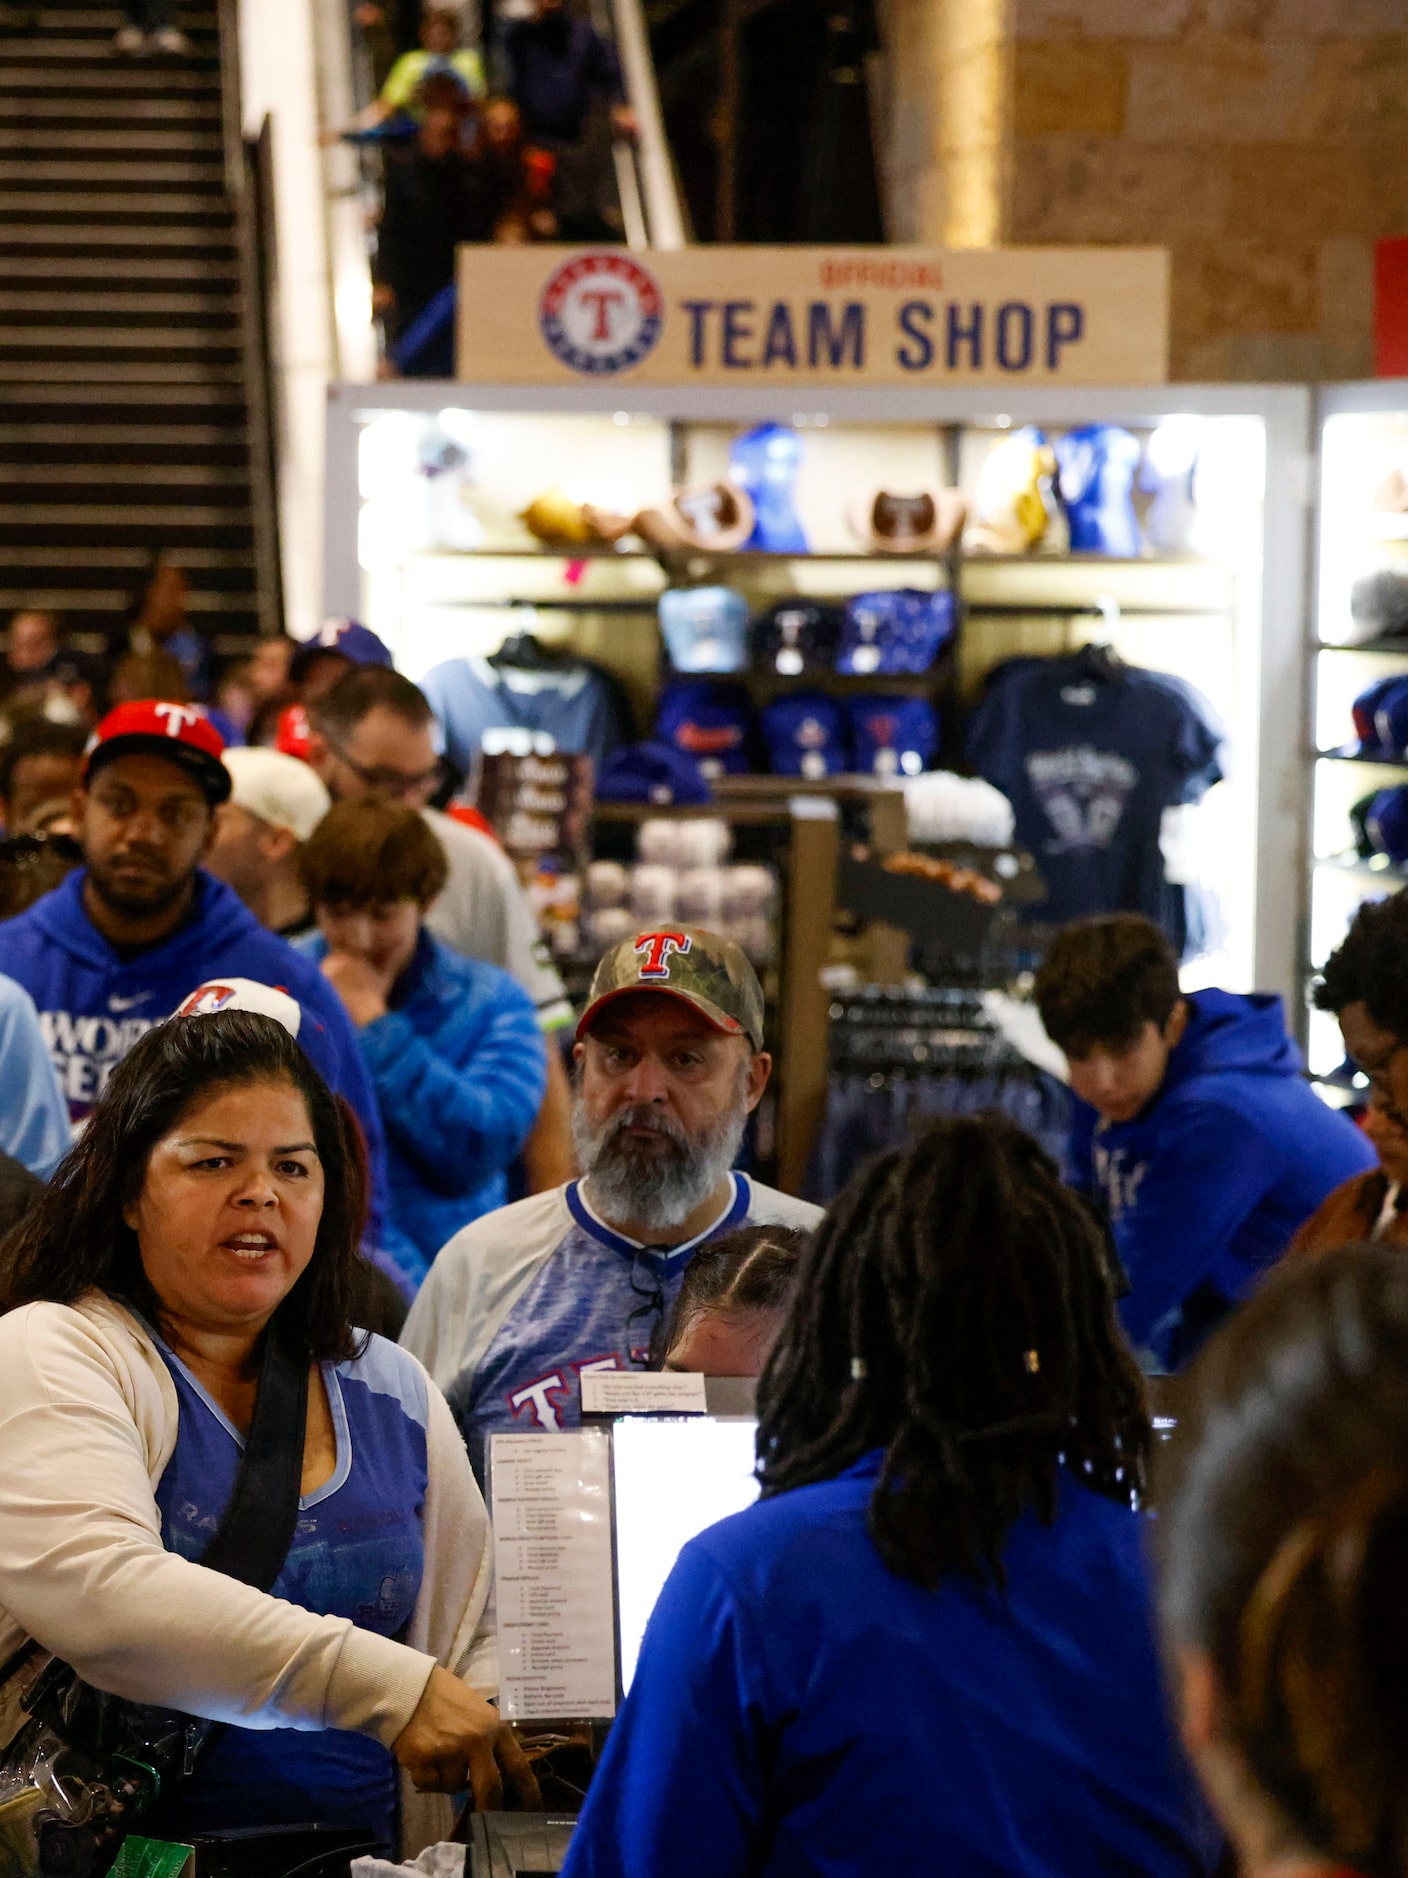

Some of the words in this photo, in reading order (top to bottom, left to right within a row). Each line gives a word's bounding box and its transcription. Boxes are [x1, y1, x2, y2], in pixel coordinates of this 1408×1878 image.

[680, 300, 866, 368] TEAM
[896, 302, 1084, 370] SHOP
[154, 702, 197, 737] T
[633, 932, 692, 980] T
[42, 1011, 172, 1055] WOR
